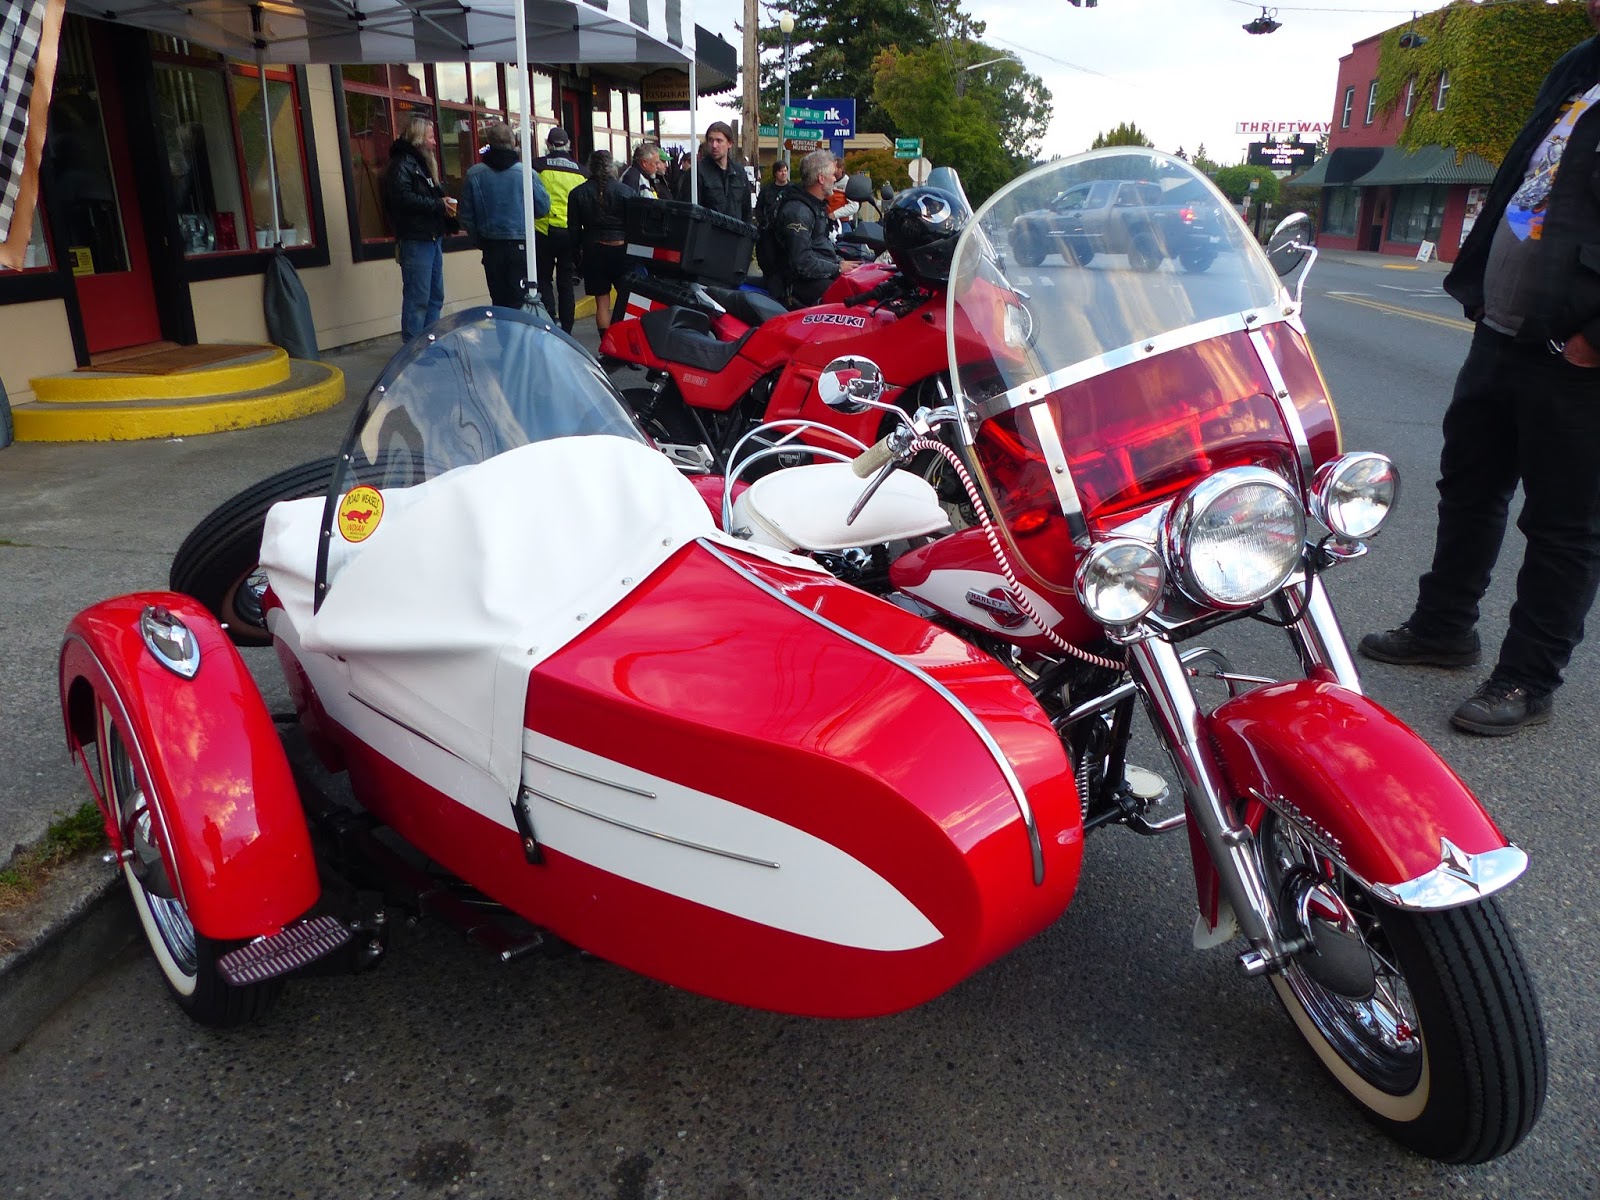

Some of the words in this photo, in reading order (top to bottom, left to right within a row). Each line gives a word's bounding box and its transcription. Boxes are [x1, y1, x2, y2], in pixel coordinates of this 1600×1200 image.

[645, 90, 688, 99] RESTAURAN
[1240, 122, 1332, 133] THRIFTWAY
[802, 314, 866, 328] SUZUKI
[346, 493, 360, 506] ROAD
[346, 523, 366, 532] INDIAN
